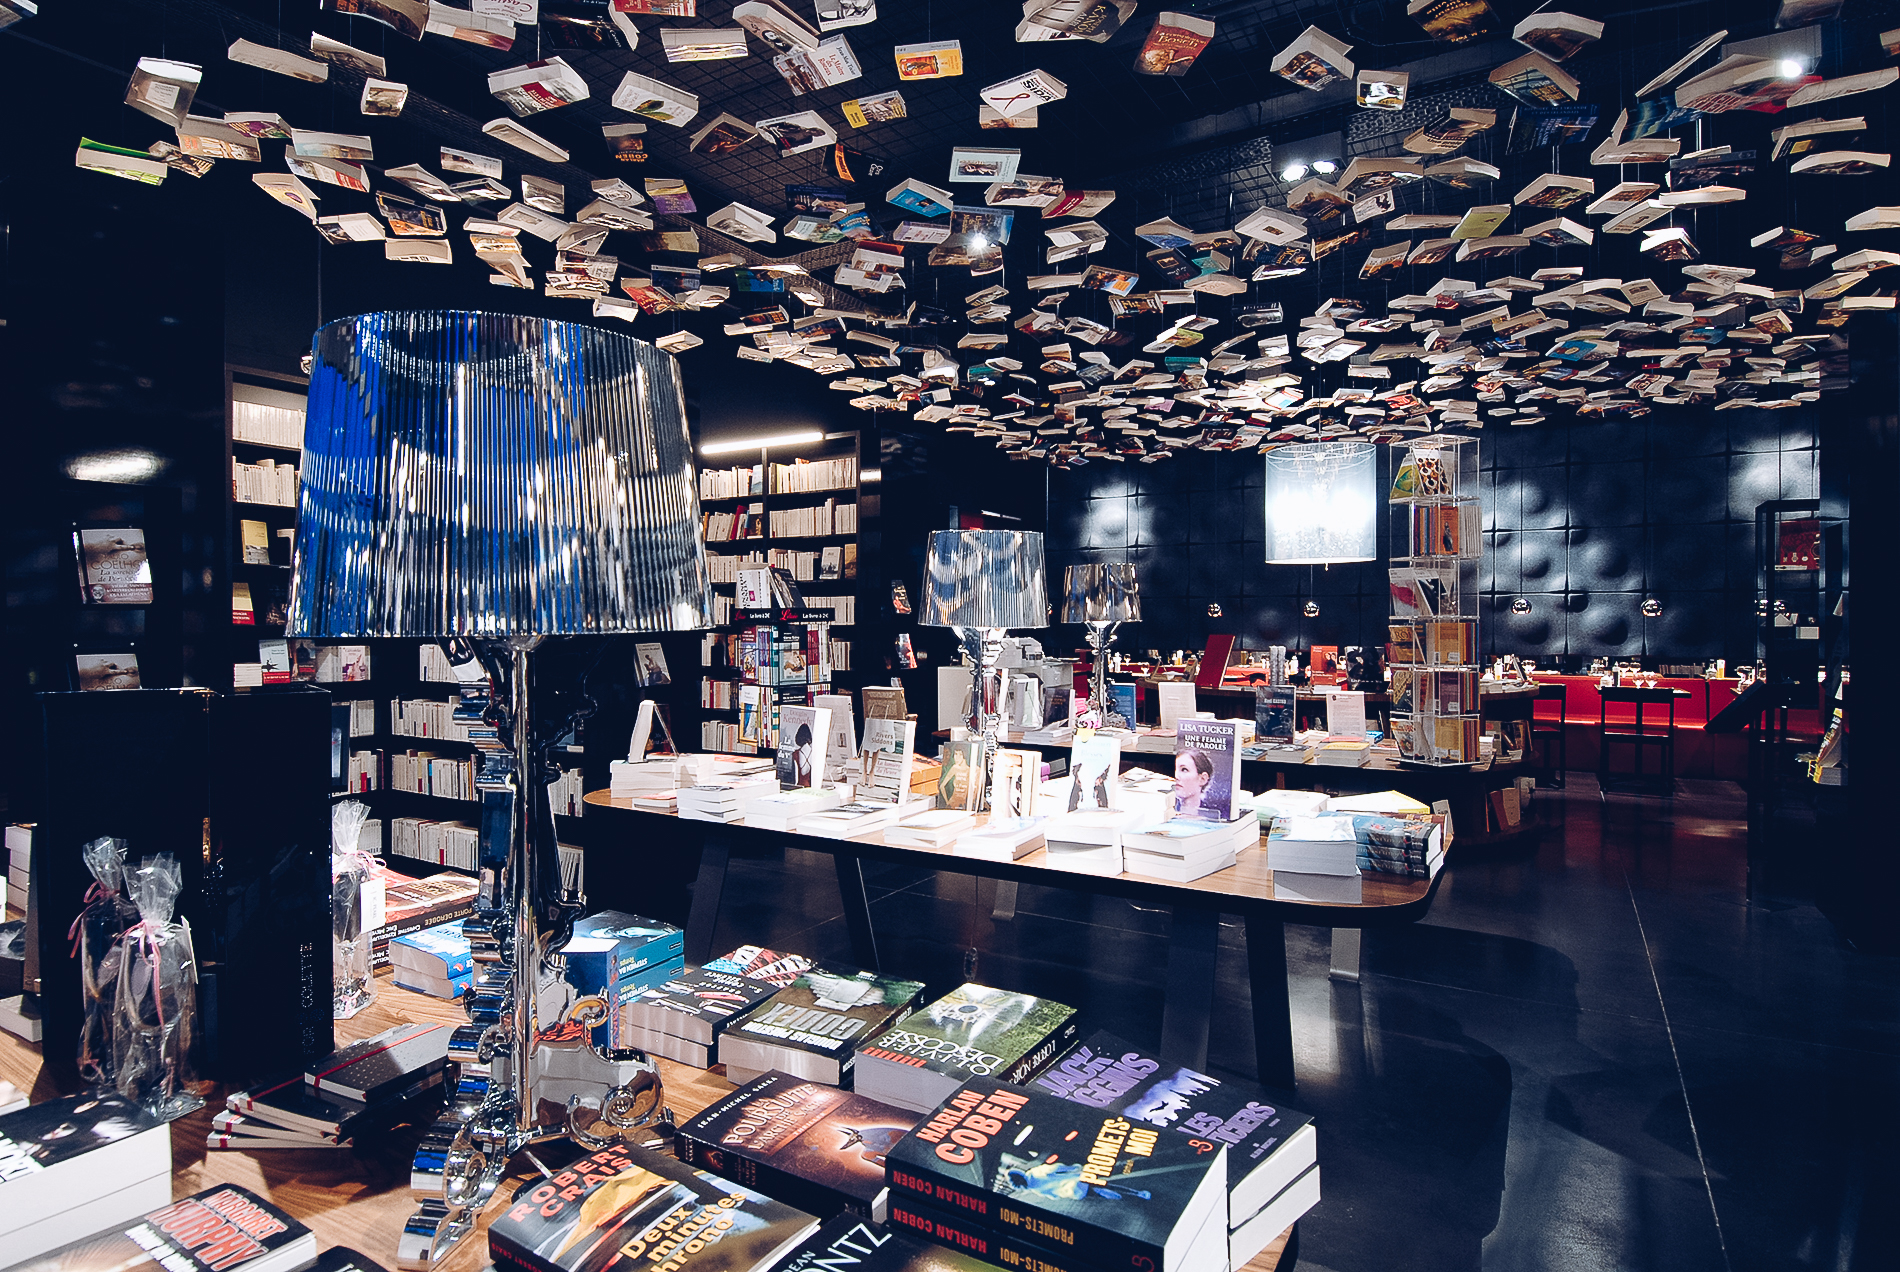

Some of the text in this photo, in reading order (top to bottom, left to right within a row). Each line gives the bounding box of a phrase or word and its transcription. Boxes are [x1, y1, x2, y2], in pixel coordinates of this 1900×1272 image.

[1071, 4, 1107, 35] KANON
[1180, 723, 1234, 736] LISA TUCKER
[1196, 742, 1227, 751] PAROLES
[1202, 736, 1227, 744] FEMME
[626, 958, 648, 971] STEPHEN
[627, 984, 649, 998] STEPHEN
[740, 1020, 843, 1051] DOUGLAS PRESTON
[752, 1001, 867, 1040] CODEX
[894, 1029, 1004, 1071] DESCOSSE
[1036, 1046, 1114, 1098] JACK
[1070, 1052, 1160, 1108] IGGINS
[697, 1091, 752, 1129] JEAN-MICHEL
[722, 1083, 818, 1145] POURSUITE
[916, 1089, 986, 1144] HARLAN
[934, 1088, 1030, 1165] COBEN
[1176, 1112, 1224, 1138] LES
[748, 1116, 798, 1150] L'ARCHE
[1124, 1128, 1159, 1157] MOI
[508, 1144, 630, 1223] ROBERT
[539, 1156, 633, 1218] CRAIS
[893, 1170, 987, 1214] HARLAN COBEN
[144, 1198, 270, 1272] MURPHY
[201, 1188, 289, 1242] MARGARET
[619, 1206, 694, 1260] Deux
[646, 1191, 747, 1263] minutes
[893, 1208, 987, 1254] HARLAN COBEN
[1000, 1207, 1074, 1246] PROMETS-MOI
[650, 1218, 734, 1272] hrono
